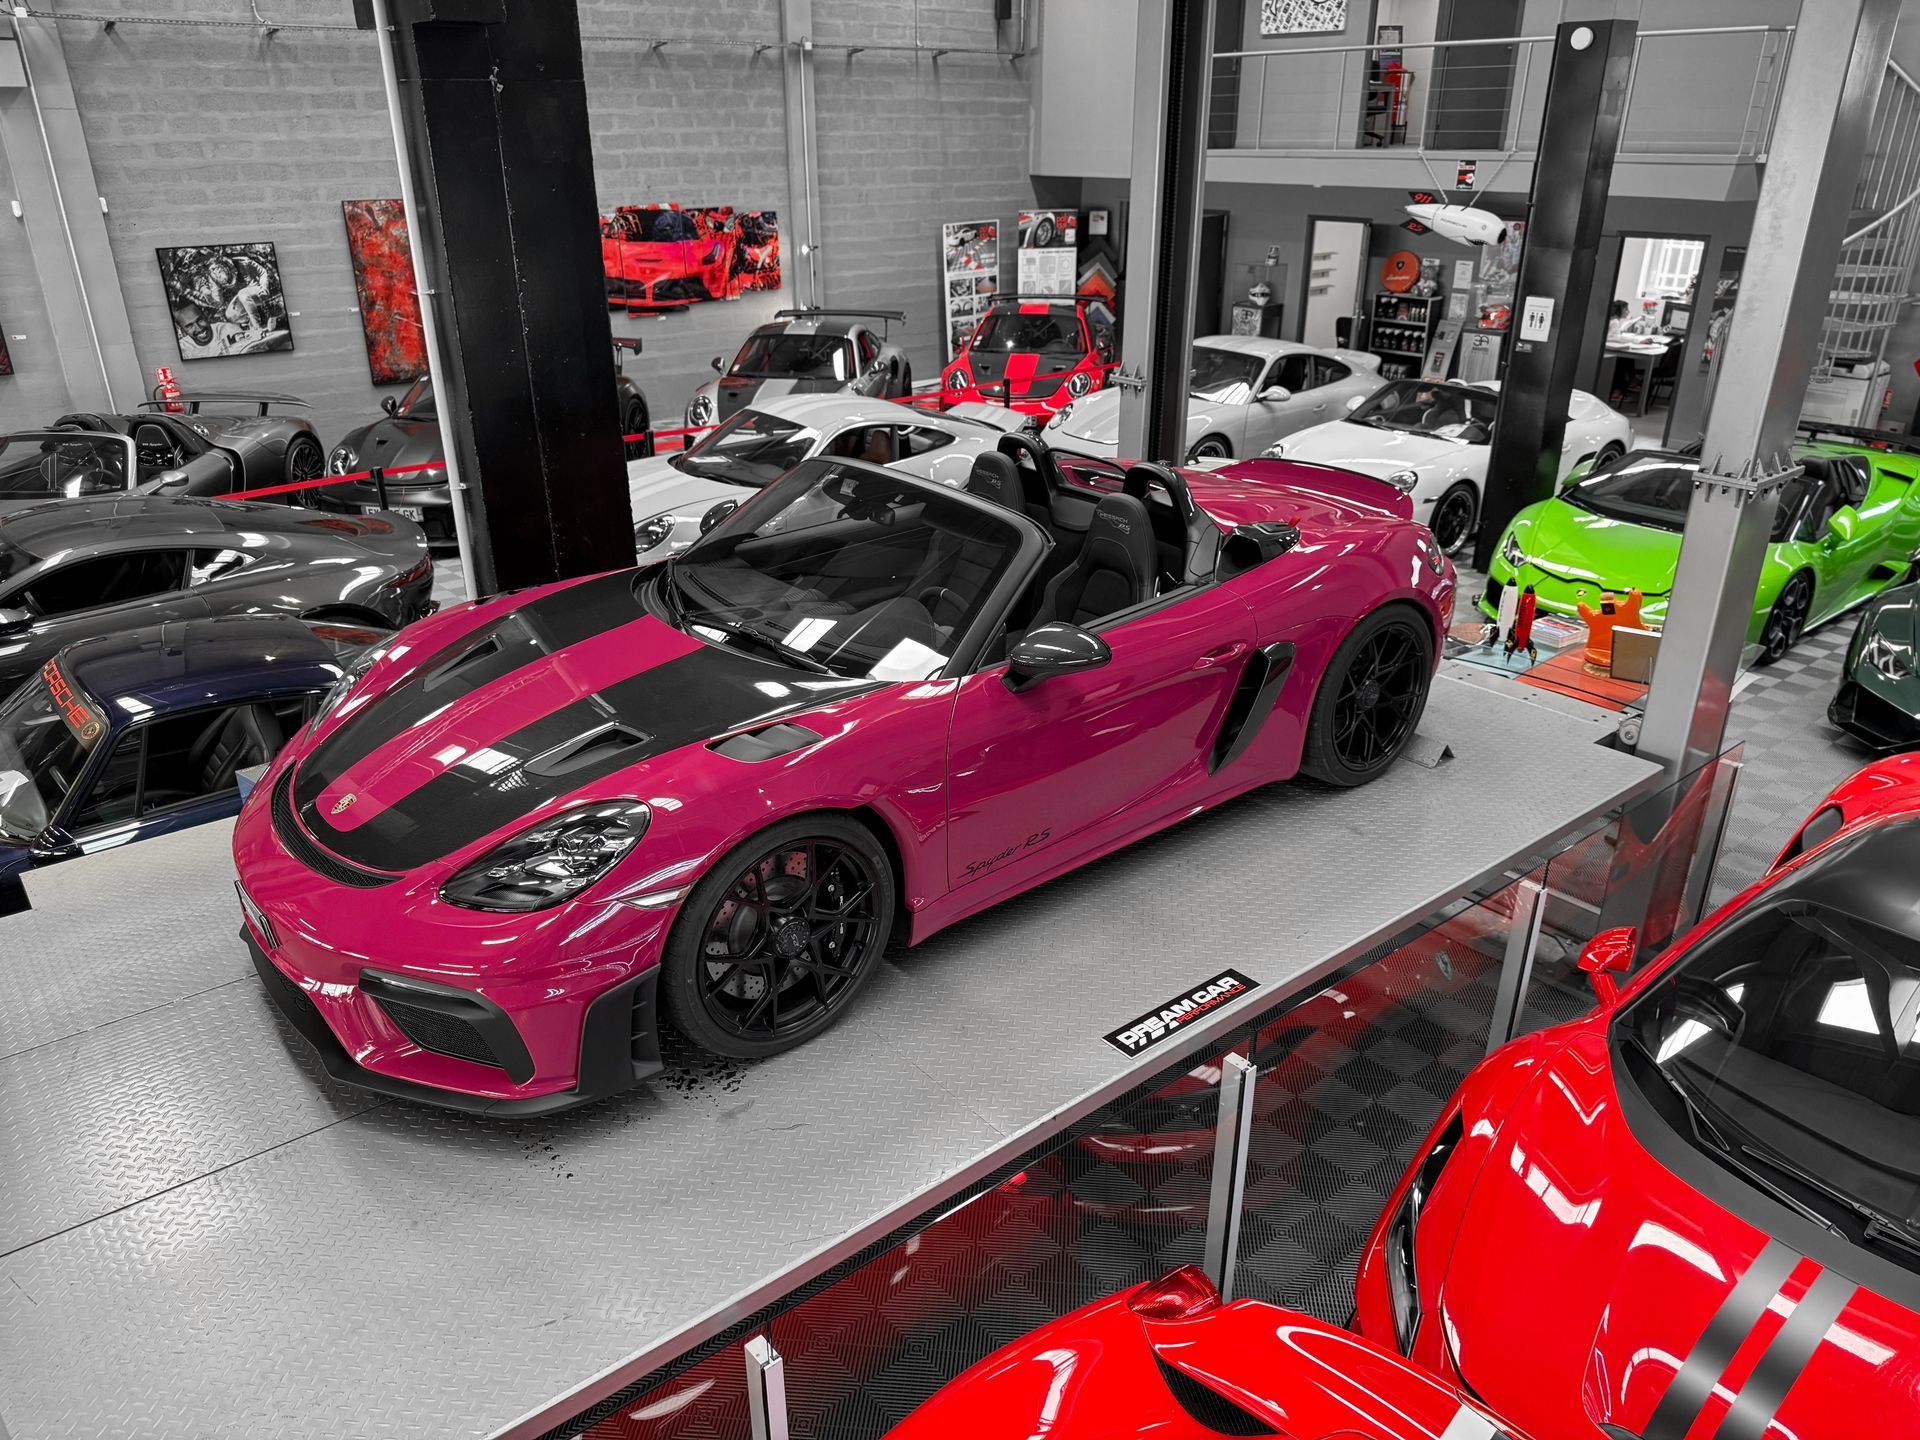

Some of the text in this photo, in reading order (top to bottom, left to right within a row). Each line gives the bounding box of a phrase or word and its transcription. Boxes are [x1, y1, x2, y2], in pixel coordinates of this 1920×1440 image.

[1414, 193, 1433, 204] 911
[957, 827, 1053, 878] Spyder RS
[1116, 976, 1240, 1047] DREAM CAR
[1176, 983, 1247, 1024] PERFORMANCE
